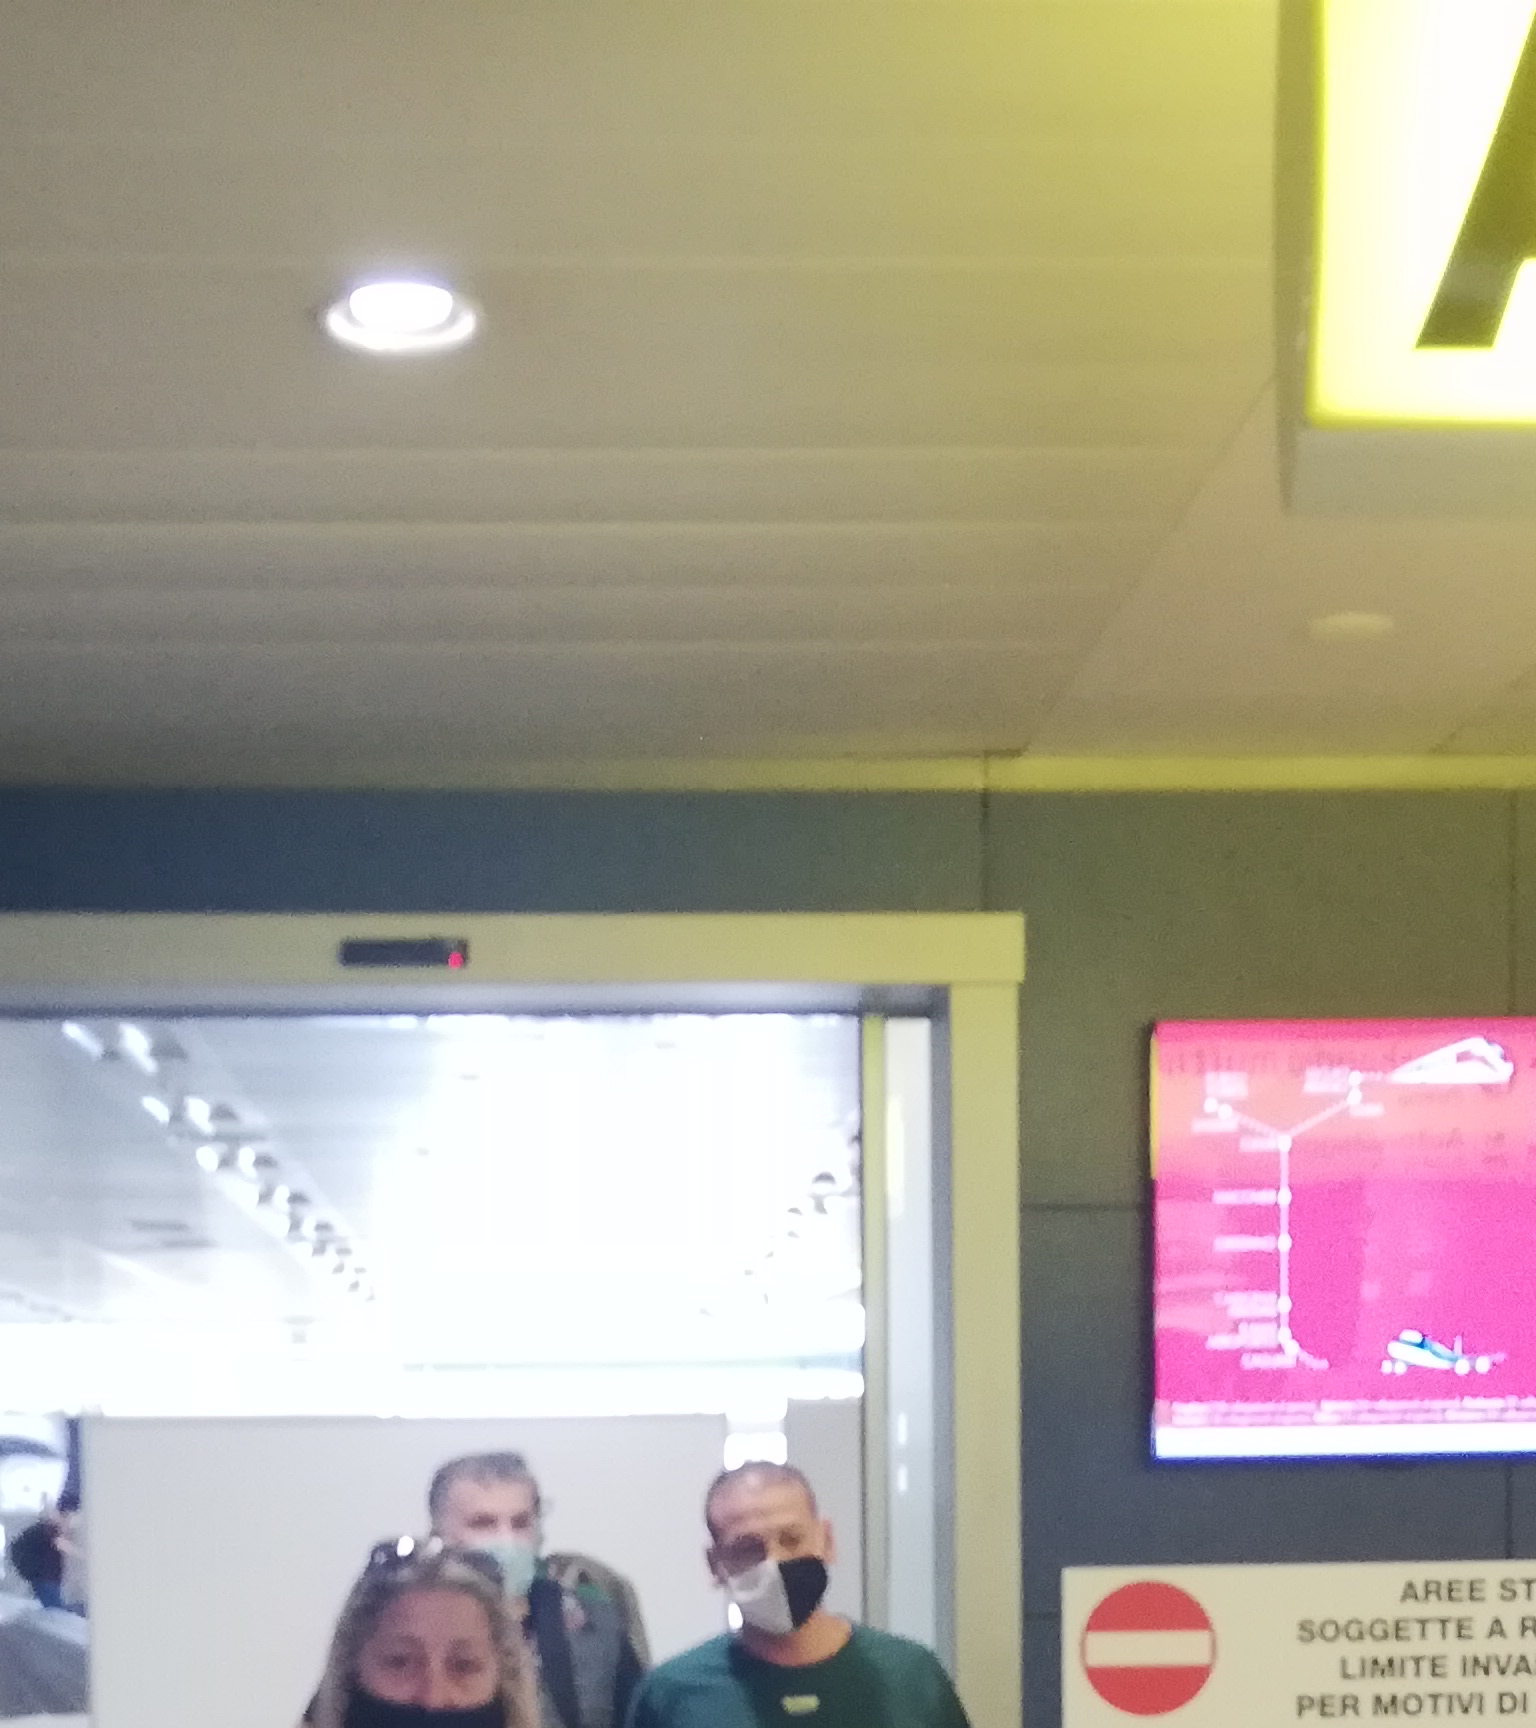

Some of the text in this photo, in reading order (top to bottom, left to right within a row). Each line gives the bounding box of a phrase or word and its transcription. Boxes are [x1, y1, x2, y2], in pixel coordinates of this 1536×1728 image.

[1400, 1578, 1486, 1603] AREE
[1297, 1616, 1474, 1642] SOGGETTE
[1487, 1616, 1507, 1640] A
[1340, 1654, 1448, 1680] LIMITE
[1296, 1693, 1360, 1718] PER
[1372, 1691, 1484, 1716] MOTIVI
[1498, 1690, 1527, 1714] DI
